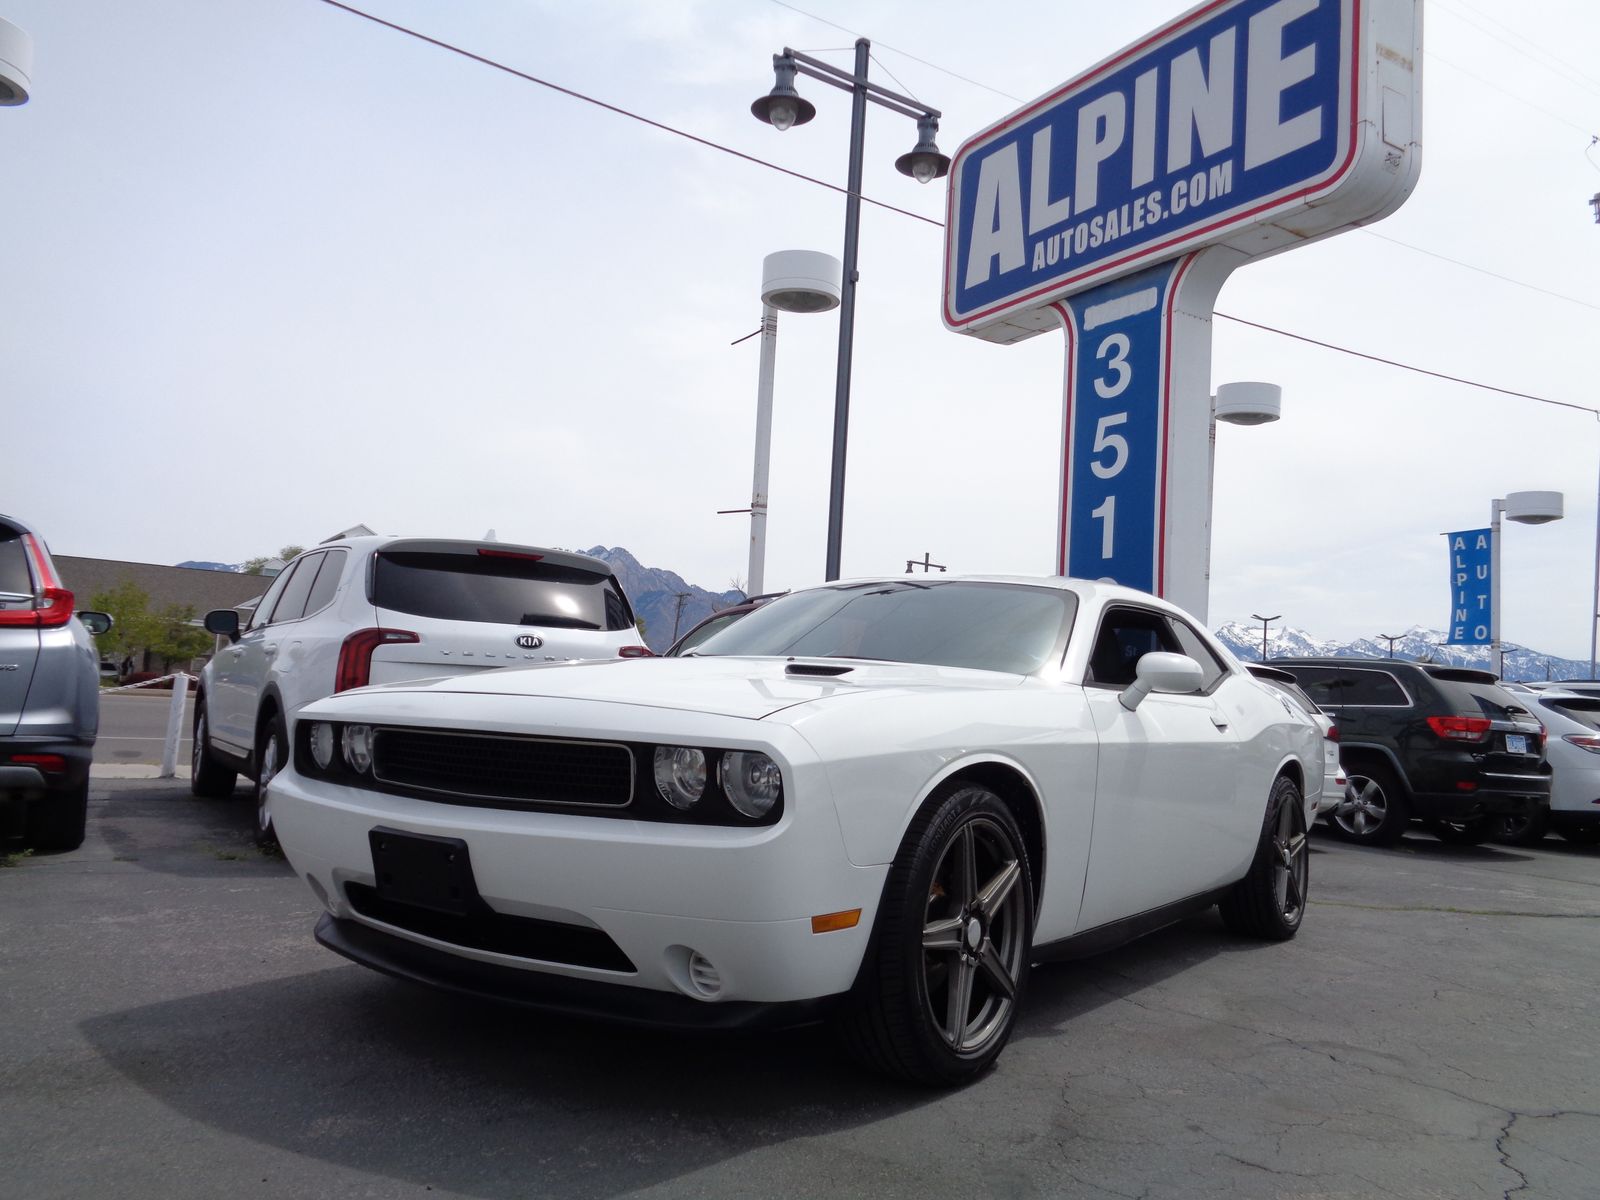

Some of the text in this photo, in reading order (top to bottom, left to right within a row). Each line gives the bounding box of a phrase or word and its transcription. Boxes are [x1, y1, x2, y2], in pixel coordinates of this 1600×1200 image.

[965, 0, 1322, 290] ALPINE
[1031, 160, 1233, 272] AUTOSALES.COM
[1090, 333, 1132, 585] 351
[1454, 537, 1467, 640] ALPINE
[1475, 535, 1488, 640] AUTO
[518, 636, 541, 648] KIA
